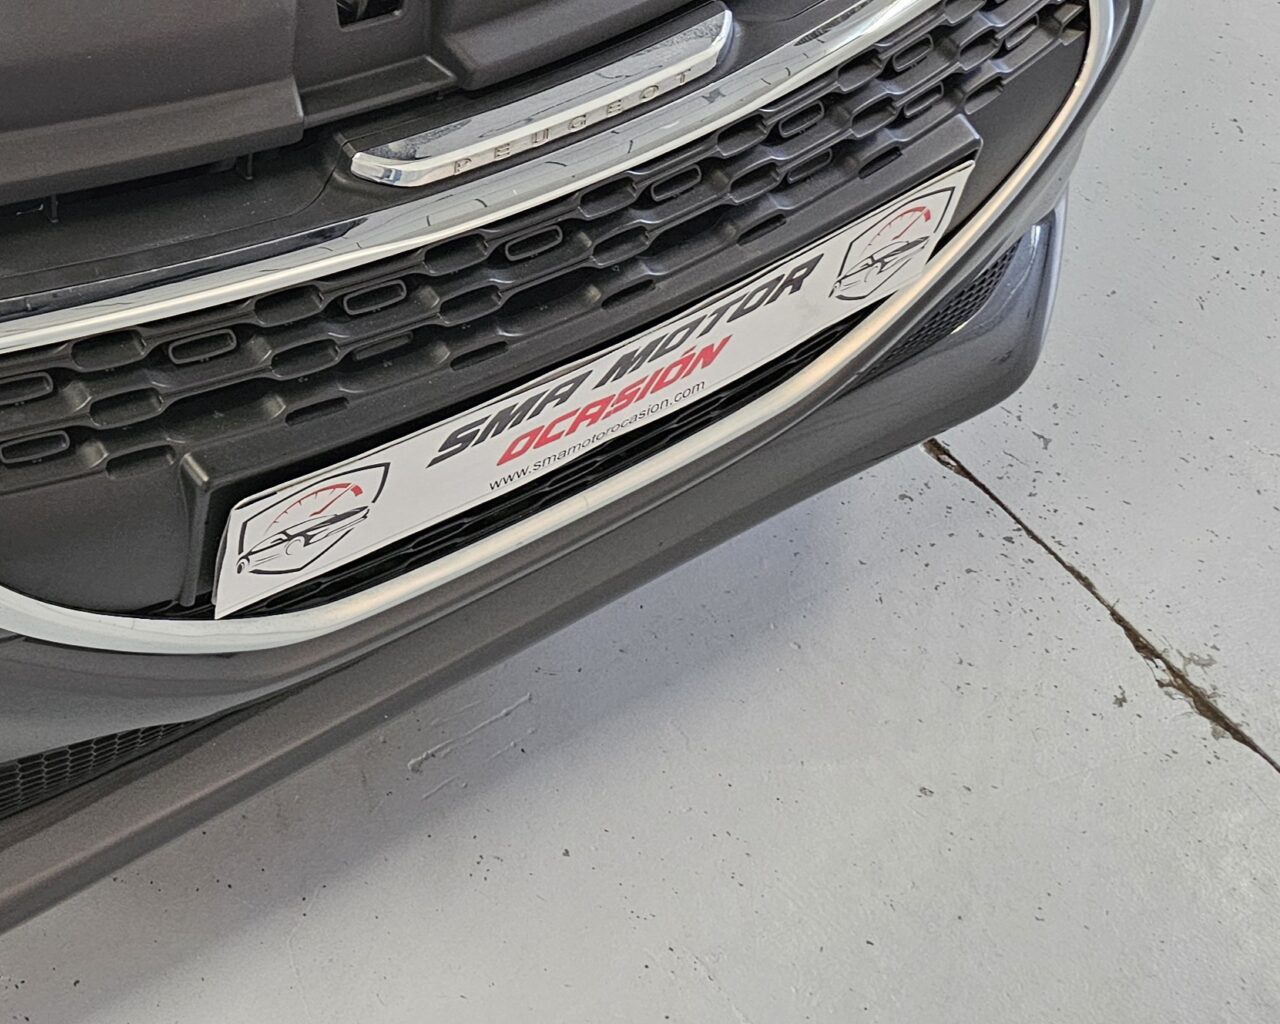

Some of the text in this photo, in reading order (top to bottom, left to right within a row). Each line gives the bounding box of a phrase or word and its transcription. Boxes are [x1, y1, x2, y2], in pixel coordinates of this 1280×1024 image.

[453, 67, 692, 175] PEUGEOT
[425, 252, 825, 469] SMA MOTOR
[496, 333, 734, 467] OCASIÓN
[488, 380, 706, 492] www.smamotorocasion.com
